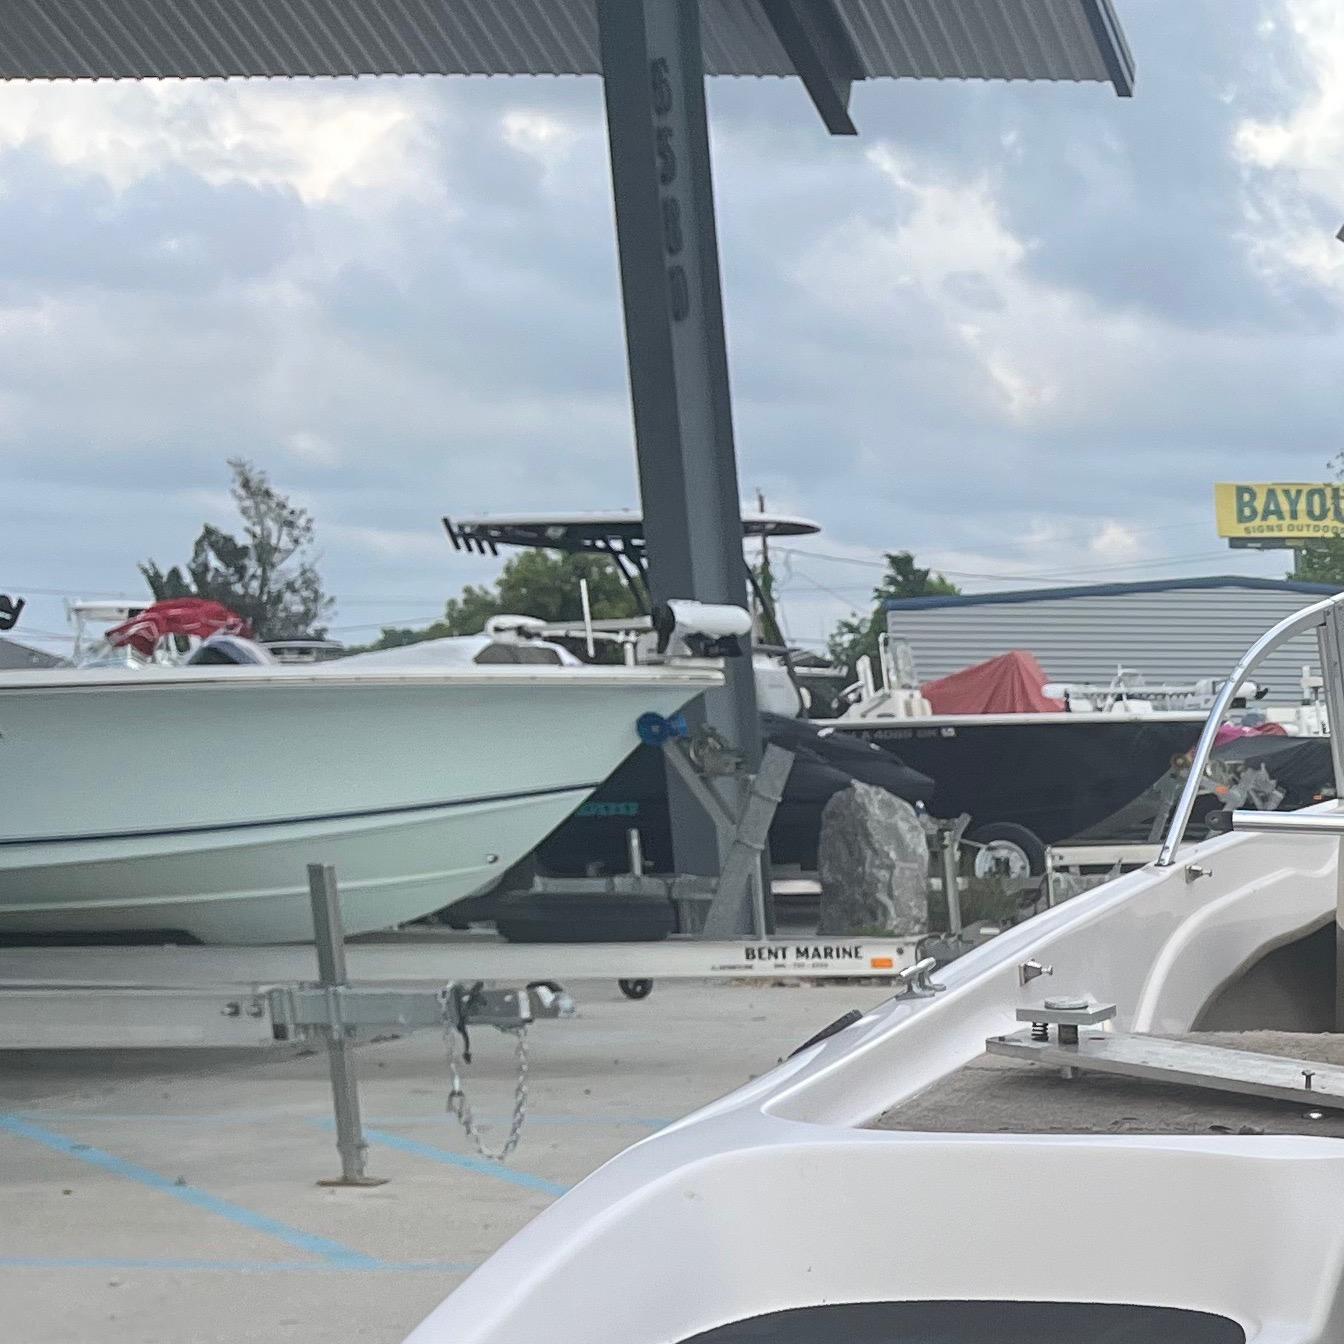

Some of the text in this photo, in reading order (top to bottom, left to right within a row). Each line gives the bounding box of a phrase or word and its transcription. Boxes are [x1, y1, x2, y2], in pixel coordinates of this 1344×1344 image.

[1244, 524, 1284, 534] SIGNS
[744, 945, 864, 961] BENT MARINE
